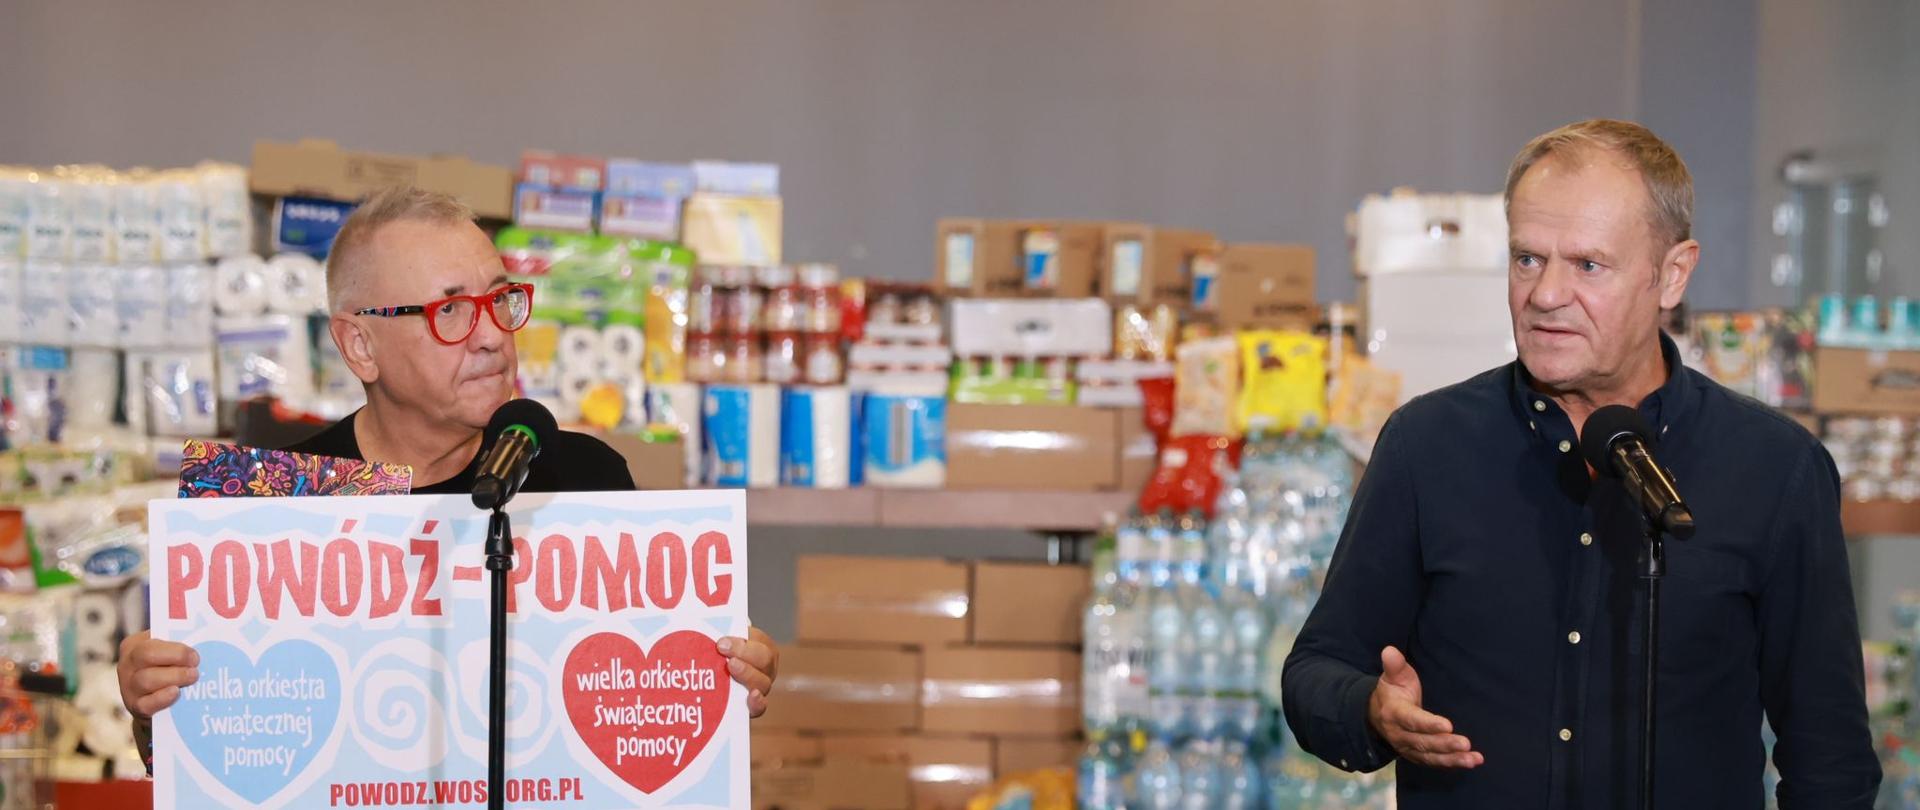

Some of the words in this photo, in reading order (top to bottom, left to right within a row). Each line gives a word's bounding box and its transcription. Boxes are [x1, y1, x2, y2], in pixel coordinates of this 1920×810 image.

[167, 518, 443, 620] POWÓDŹ
[505, 530, 733, 613] POMOC
[184, 667, 243, 700] wielka
[248, 668, 325, 700] orkiestra
[576, 657, 636, 691] wielka
[639, 659, 716, 691] orkiestra
[201, 704, 313, 748] świątecznej
[593, 695, 702, 738] świątecznej
[224, 745, 296, 776] pomocy
[616, 735, 687, 767] pomocy
[330, 777, 584, 807] POWODZ.WOSORG.PL
